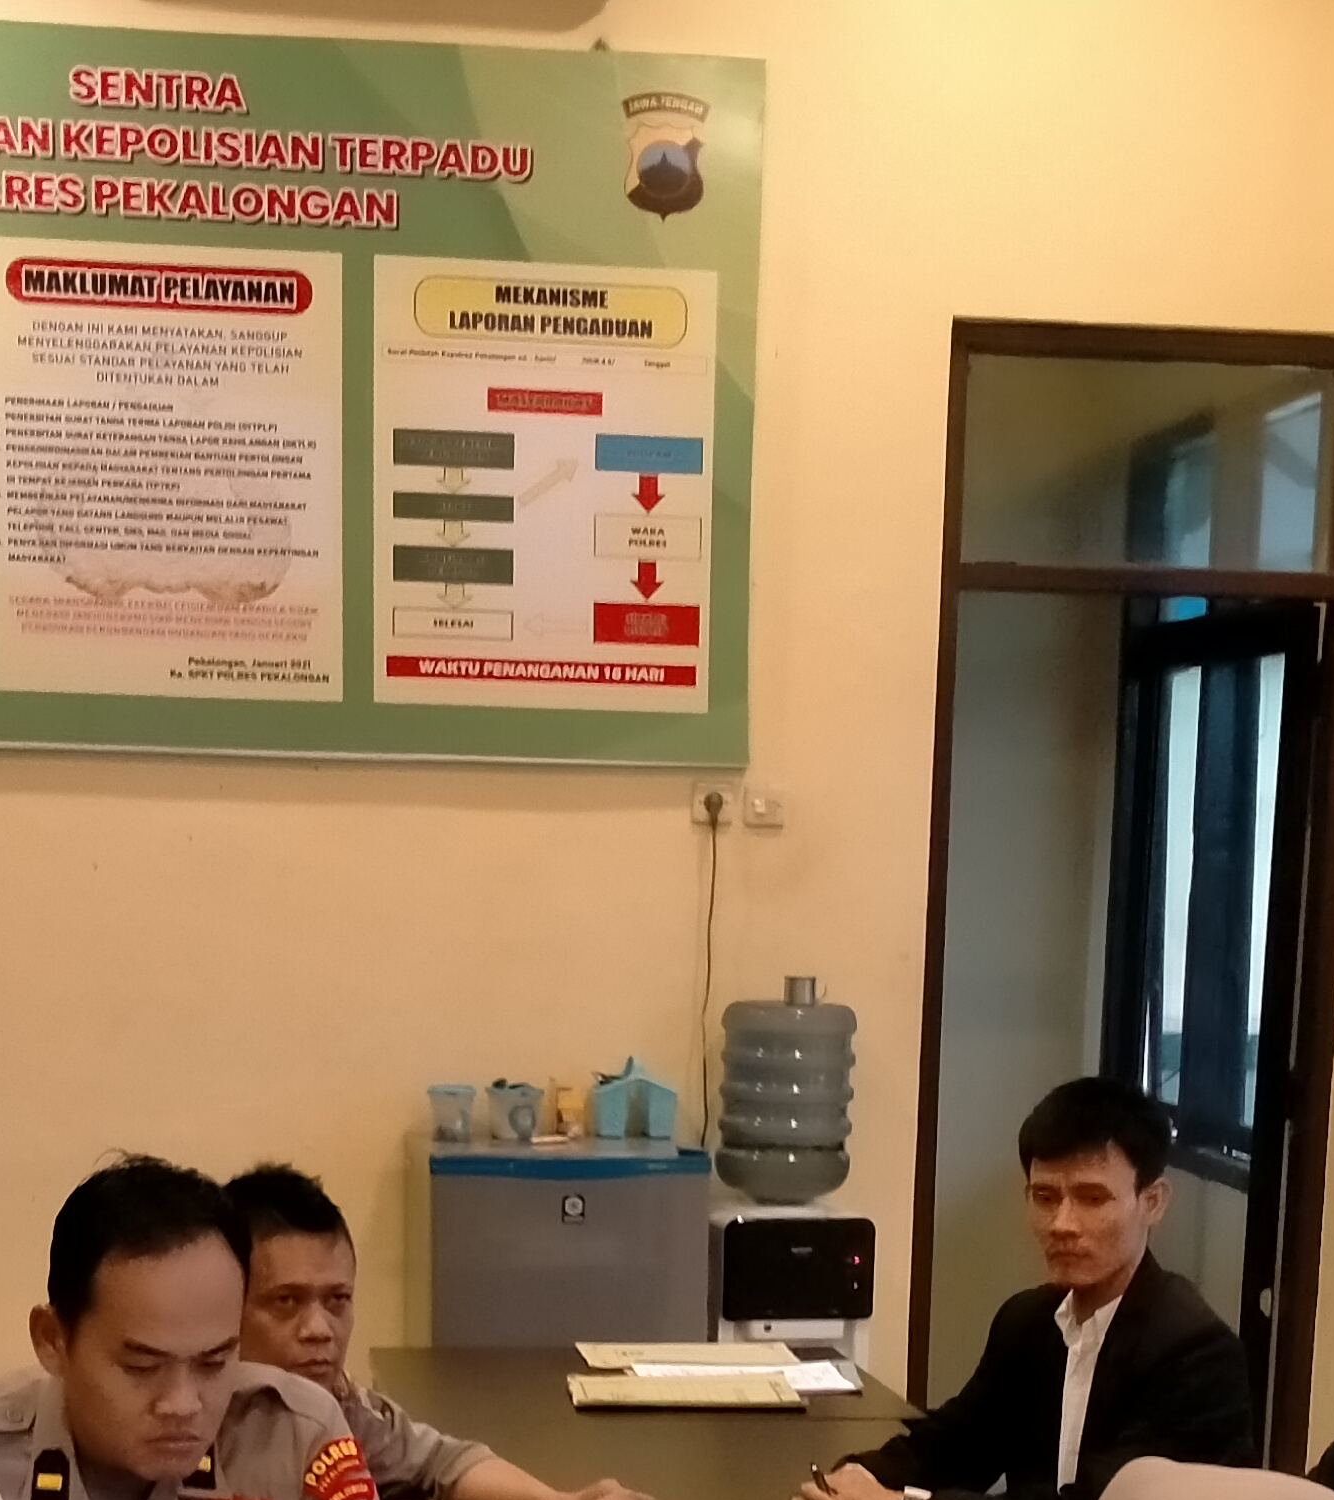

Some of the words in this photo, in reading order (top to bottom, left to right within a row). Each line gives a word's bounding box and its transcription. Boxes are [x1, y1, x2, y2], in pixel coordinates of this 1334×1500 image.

[70, 65, 248, 114] SENTRA
[60, 119, 323, 173] KEPOLISIAN
[328, 132, 533, 184] TERPADU
[92, 175, 398, 231] PEKALONGAN
[22, 268, 159, 299] MAKLUMAT
[164, 274, 297, 307] PELAYANAN
[495, 285, 609, 310] MEKANISME
[107, 324, 138, 335] KAMI
[449, 310, 536, 336] LAPORAN
[540, 315, 653, 340] PENGADUAN
[154, 342, 227, 355] PELAYANAN
[138, 357, 211, 371] PELAYANAN
[250, 362, 290, 374] TELAH
[176, 374, 220, 386] DALAM
[418, 658, 481, 677] WAKTU
[483, 660, 600, 681] PENANGANAN
[624, 666, 665, 683] HARI
